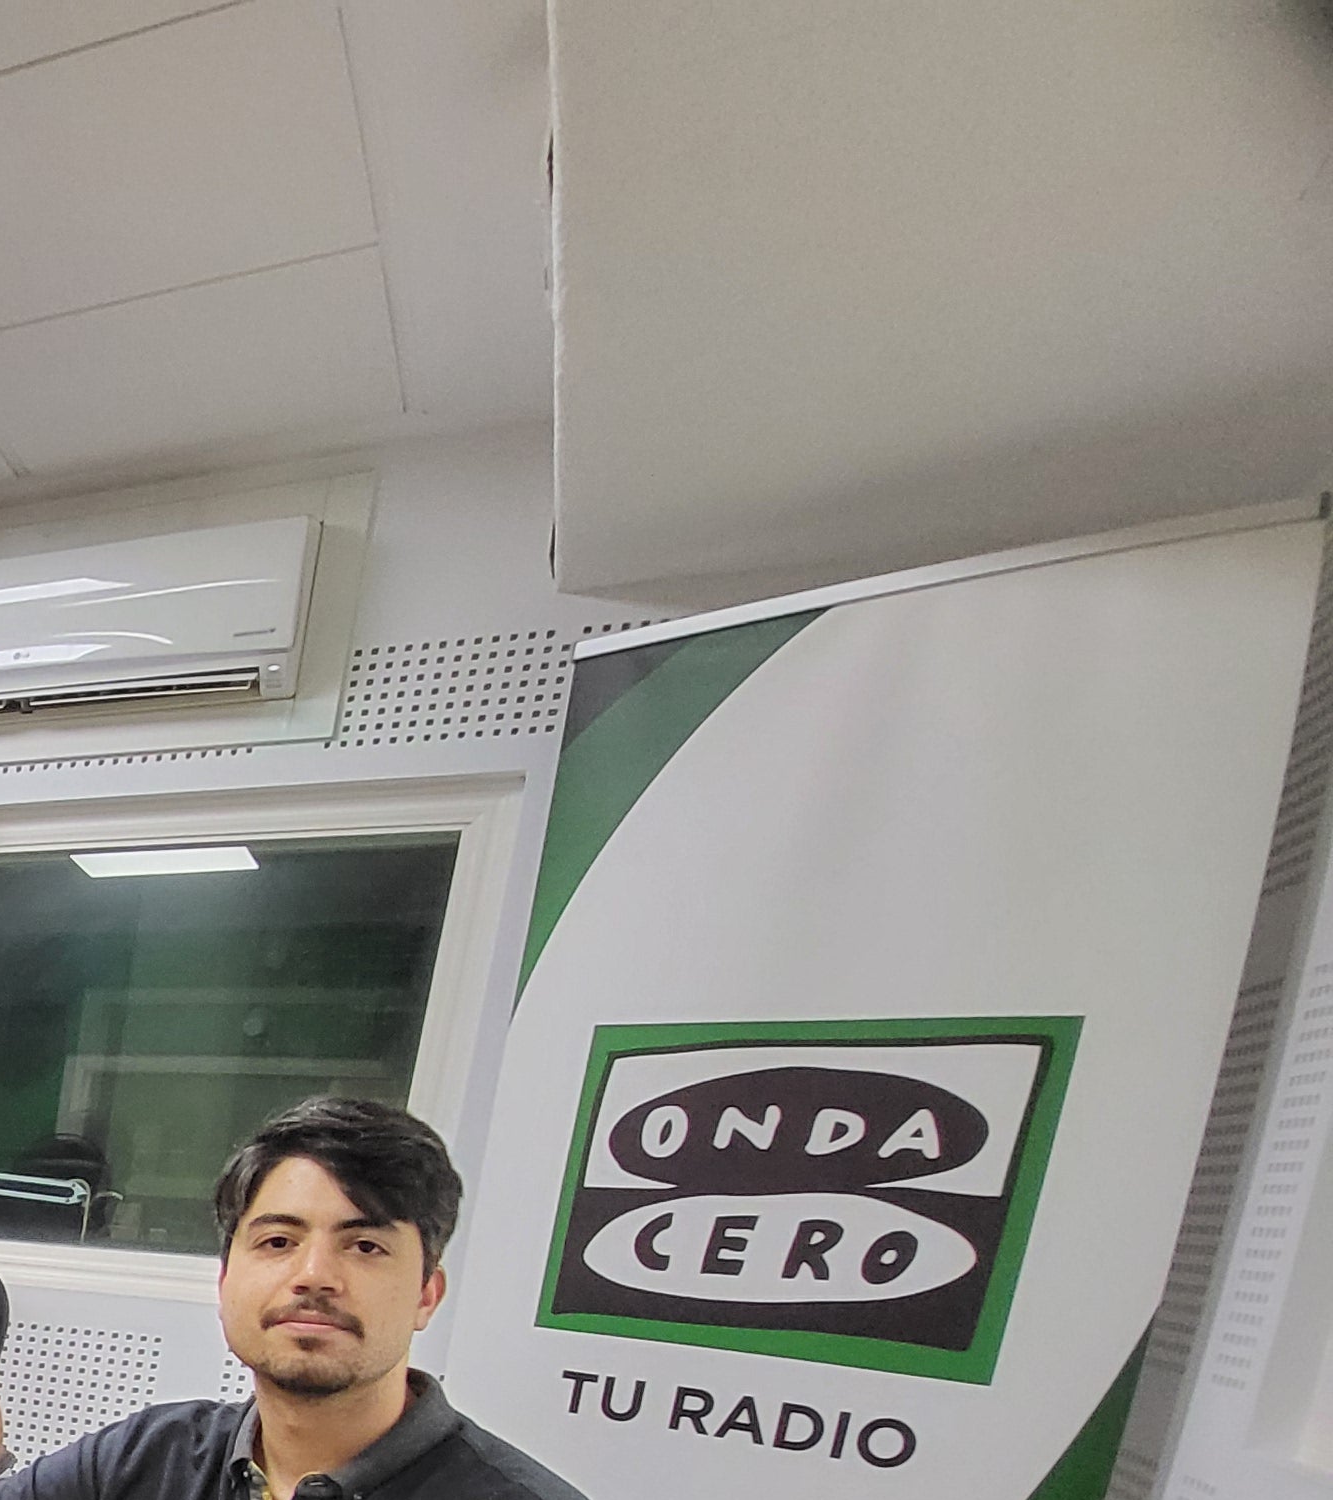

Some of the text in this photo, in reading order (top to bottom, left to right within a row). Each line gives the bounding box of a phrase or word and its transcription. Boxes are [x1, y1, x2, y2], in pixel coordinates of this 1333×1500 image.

[639, 1103, 942, 1160] ONDA
[633, 1211, 919, 1285] CERO
[561, 1369, 918, 1469] TU RADIO
